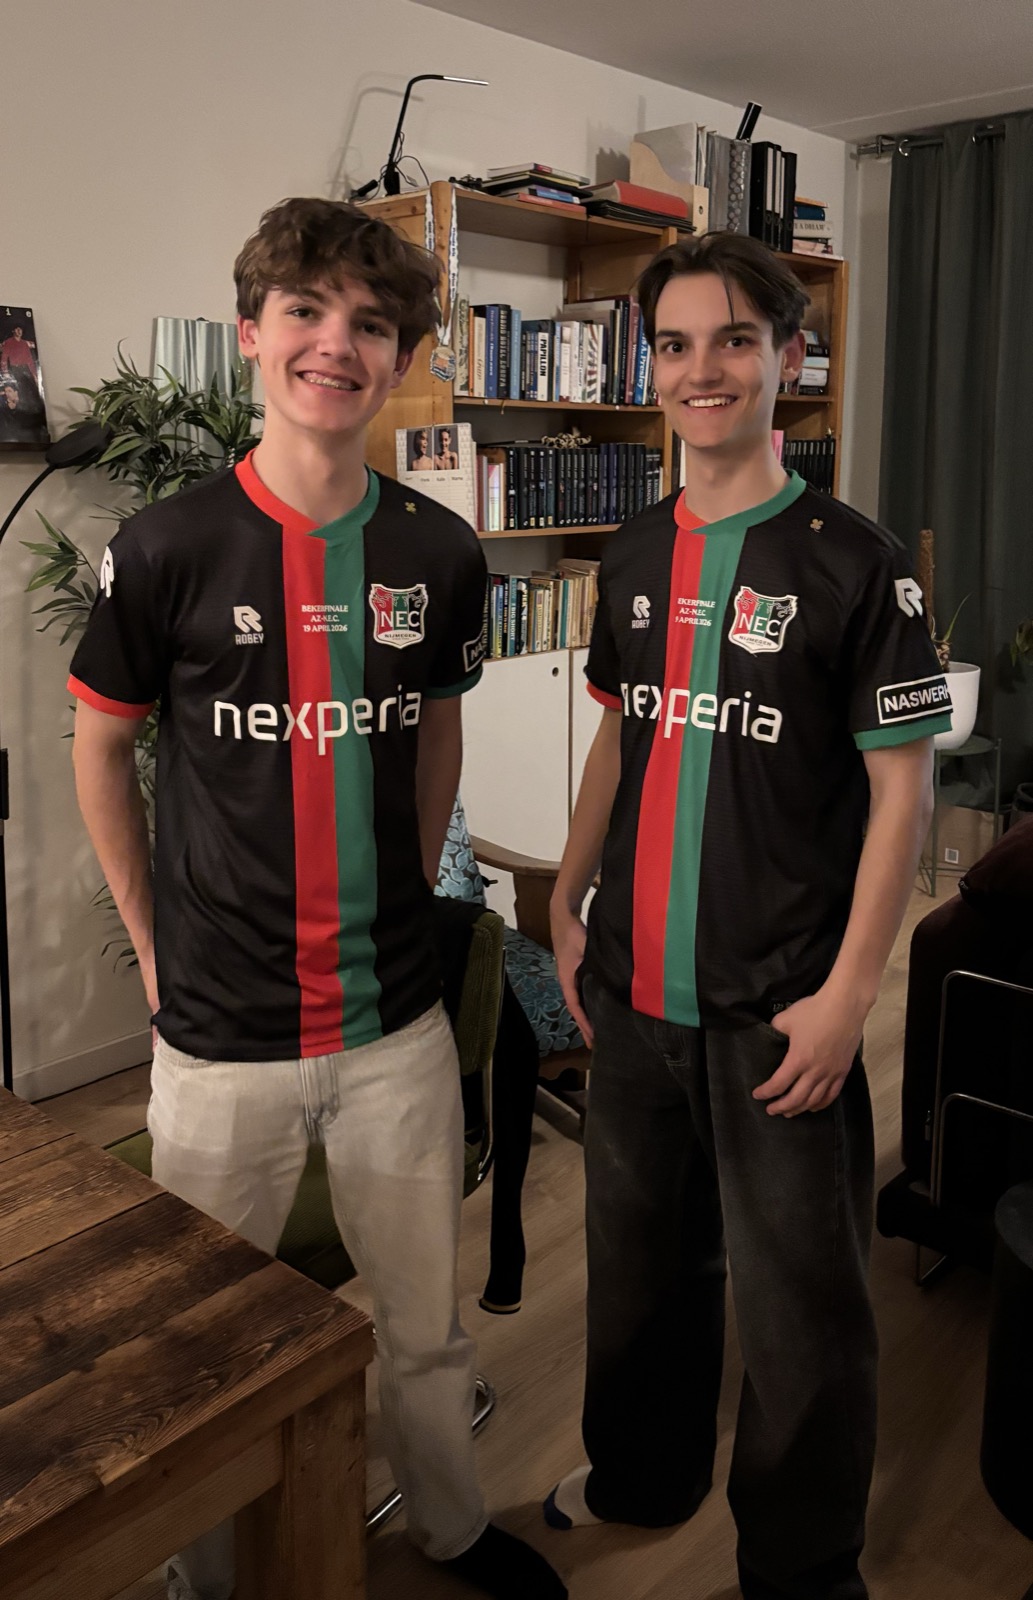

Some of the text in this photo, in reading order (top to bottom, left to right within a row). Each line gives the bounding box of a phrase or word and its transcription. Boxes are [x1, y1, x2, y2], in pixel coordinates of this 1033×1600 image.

[539, 338, 548, 377] PAPILLON
[636, 355, 647, 390] Presley
[677, 597, 716, 608] EKERFINALE
[303, 625, 348, 633] 19 APRIL 2026
[380, 610, 420, 628] NEC
[738, 612, 782, 637] NEC
[235, 632, 265, 646] ROBEY
[213, 684, 422, 756] nexperia
